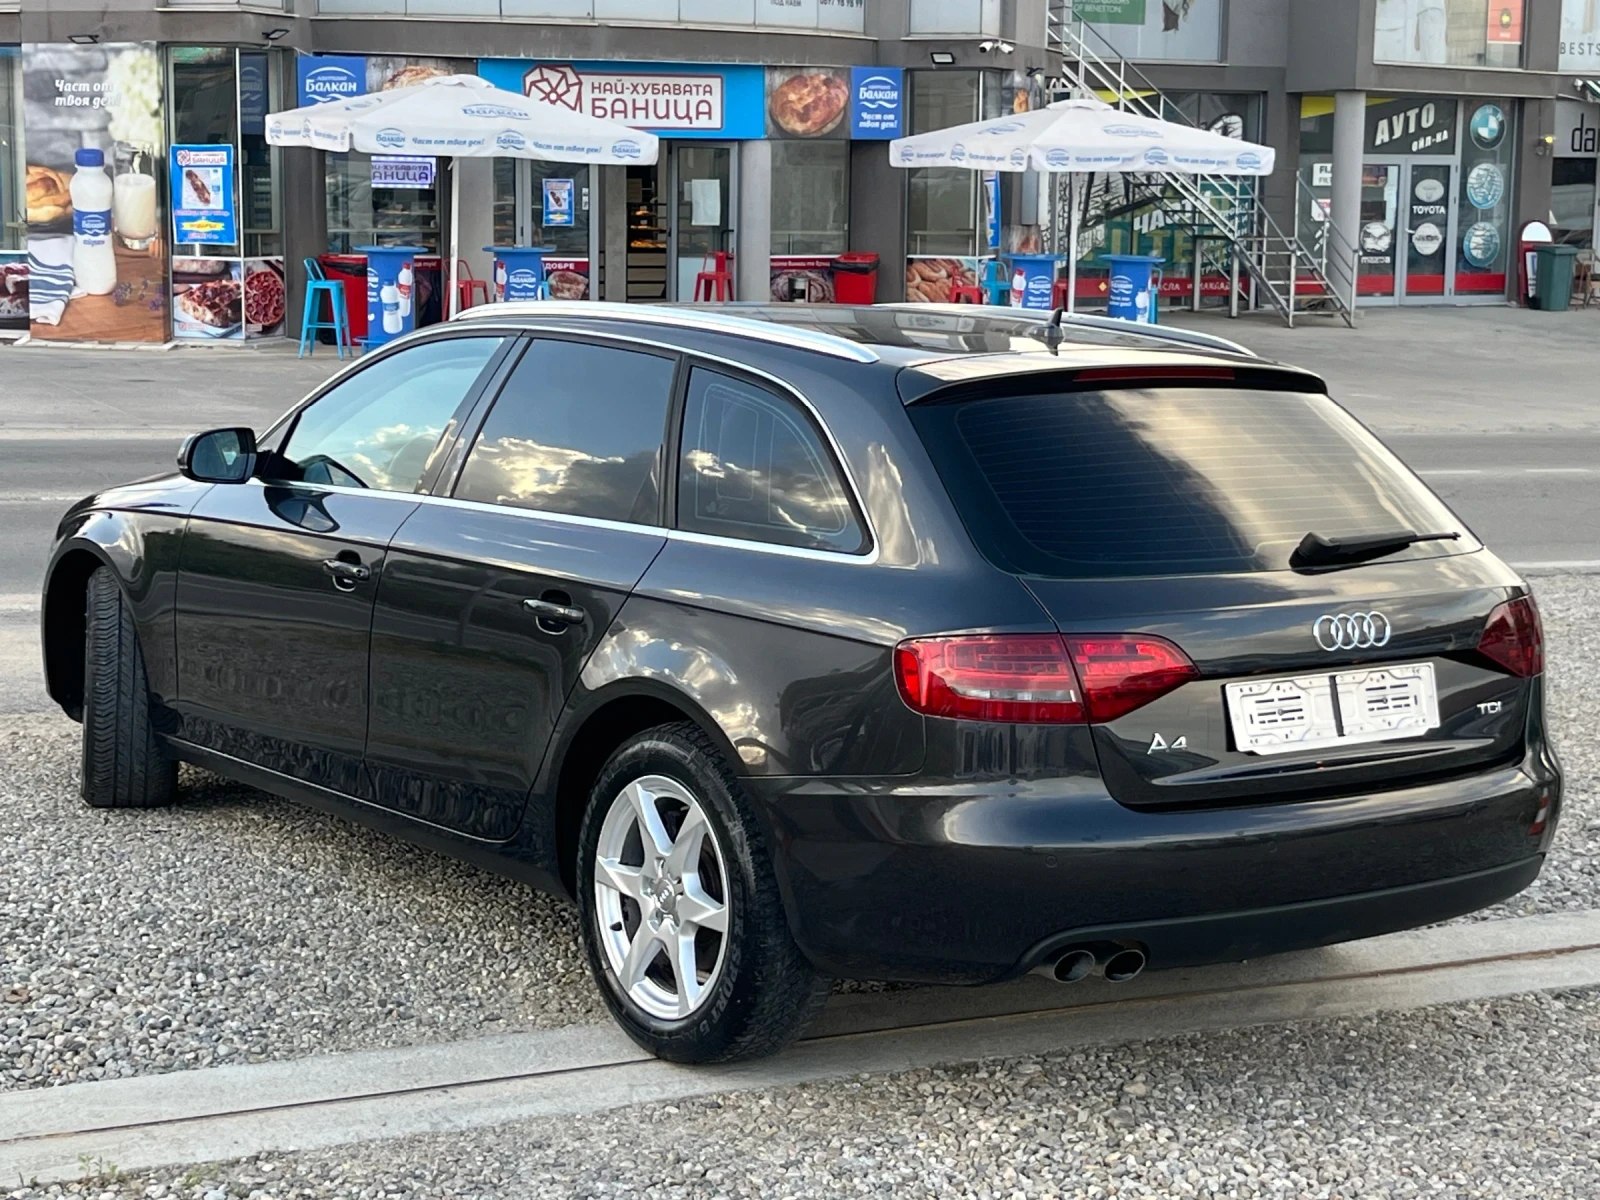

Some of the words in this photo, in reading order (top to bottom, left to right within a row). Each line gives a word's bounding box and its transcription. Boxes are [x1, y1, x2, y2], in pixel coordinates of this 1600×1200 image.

[55, 79, 90, 92] Част
[305, 79, 357, 92] Балкан
[591, 79, 713, 96] НАЙ-ХУБАВАТА
[54, 94, 90, 106] твоя
[859, 87, 898, 100] Балкан
[591, 97, 713, 124] БАНИЦА
[1374, 102, 1435, 146] АУТО
[372, 171, 429, 182] АНИЦА
[1412, 205, 1446, 214] TOYOTA
[1476, 701, 1502, 714] TDI
[1147, 732, 1188, 754] A4
